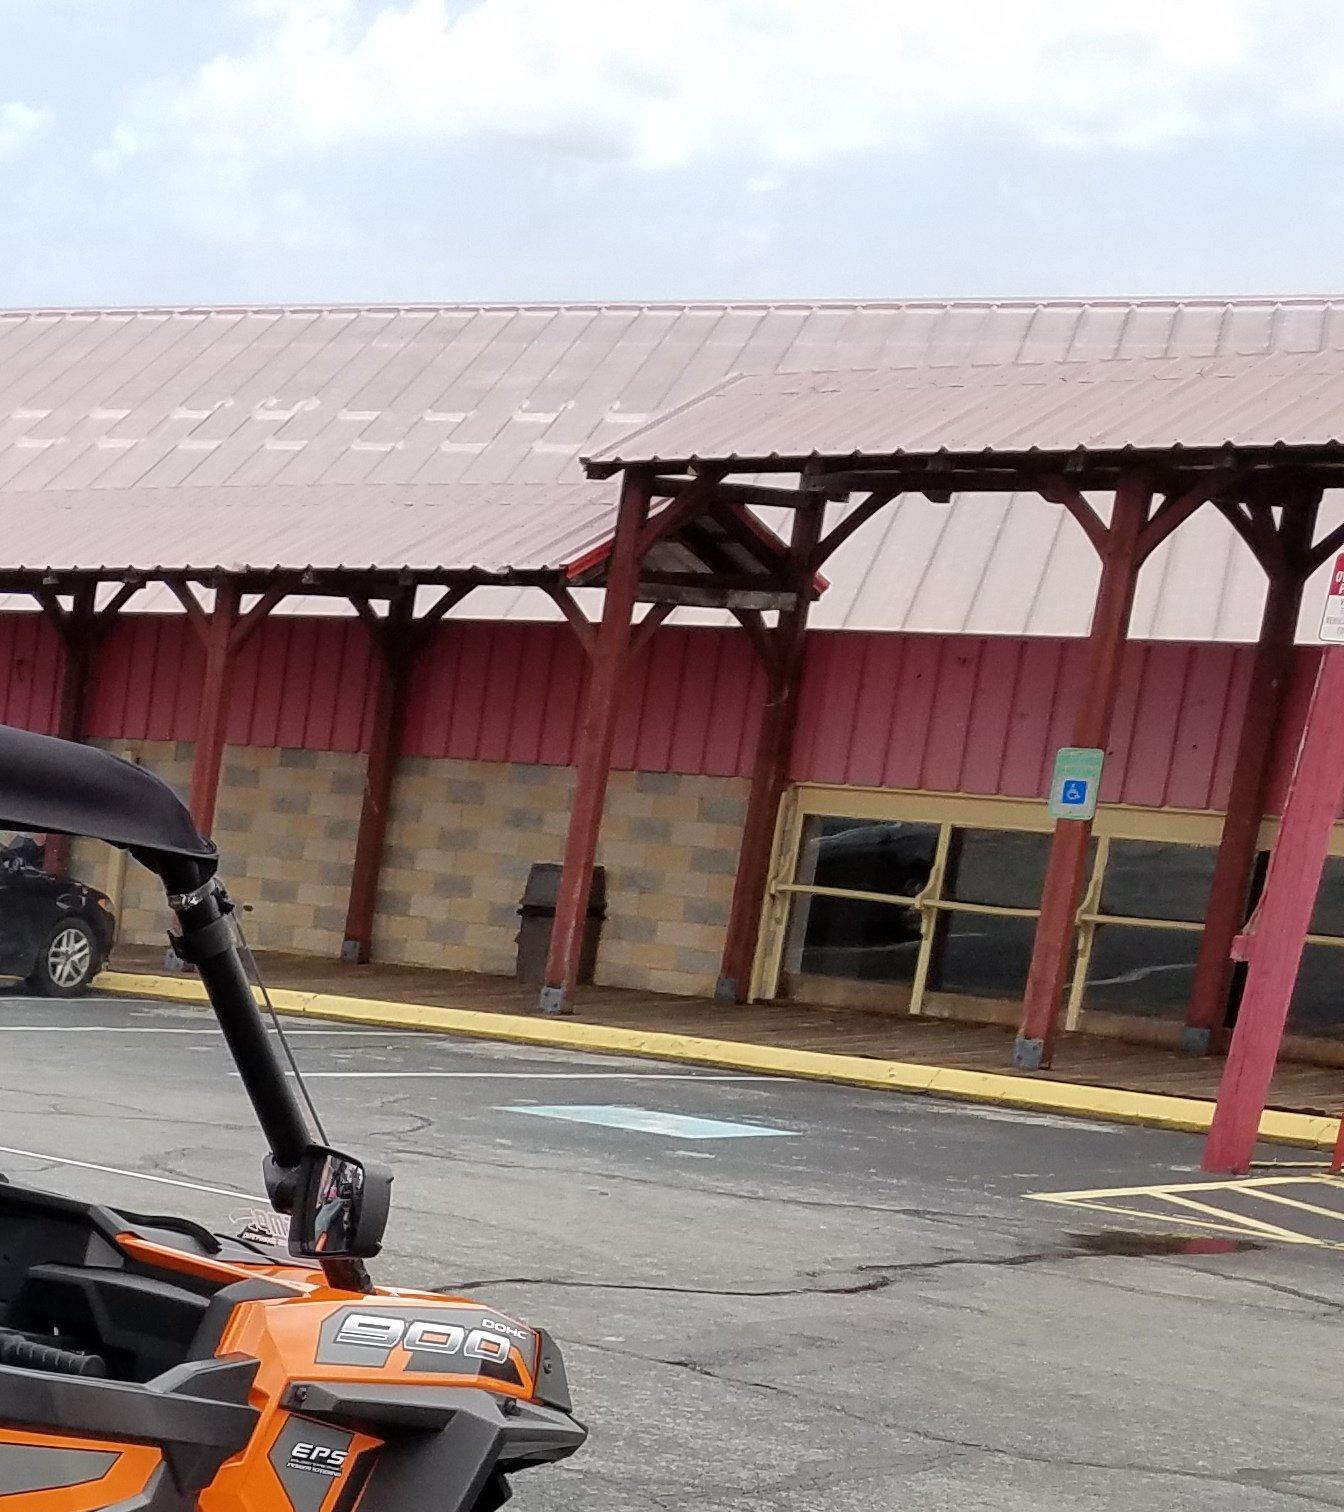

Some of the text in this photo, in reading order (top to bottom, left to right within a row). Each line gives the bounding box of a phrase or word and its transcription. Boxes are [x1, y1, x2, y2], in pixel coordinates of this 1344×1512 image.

[336, 1312, 512, 1365] 900
[480, 1318, 530, 1340] DOHC
[291, 1442, 349, 1465] EPS
